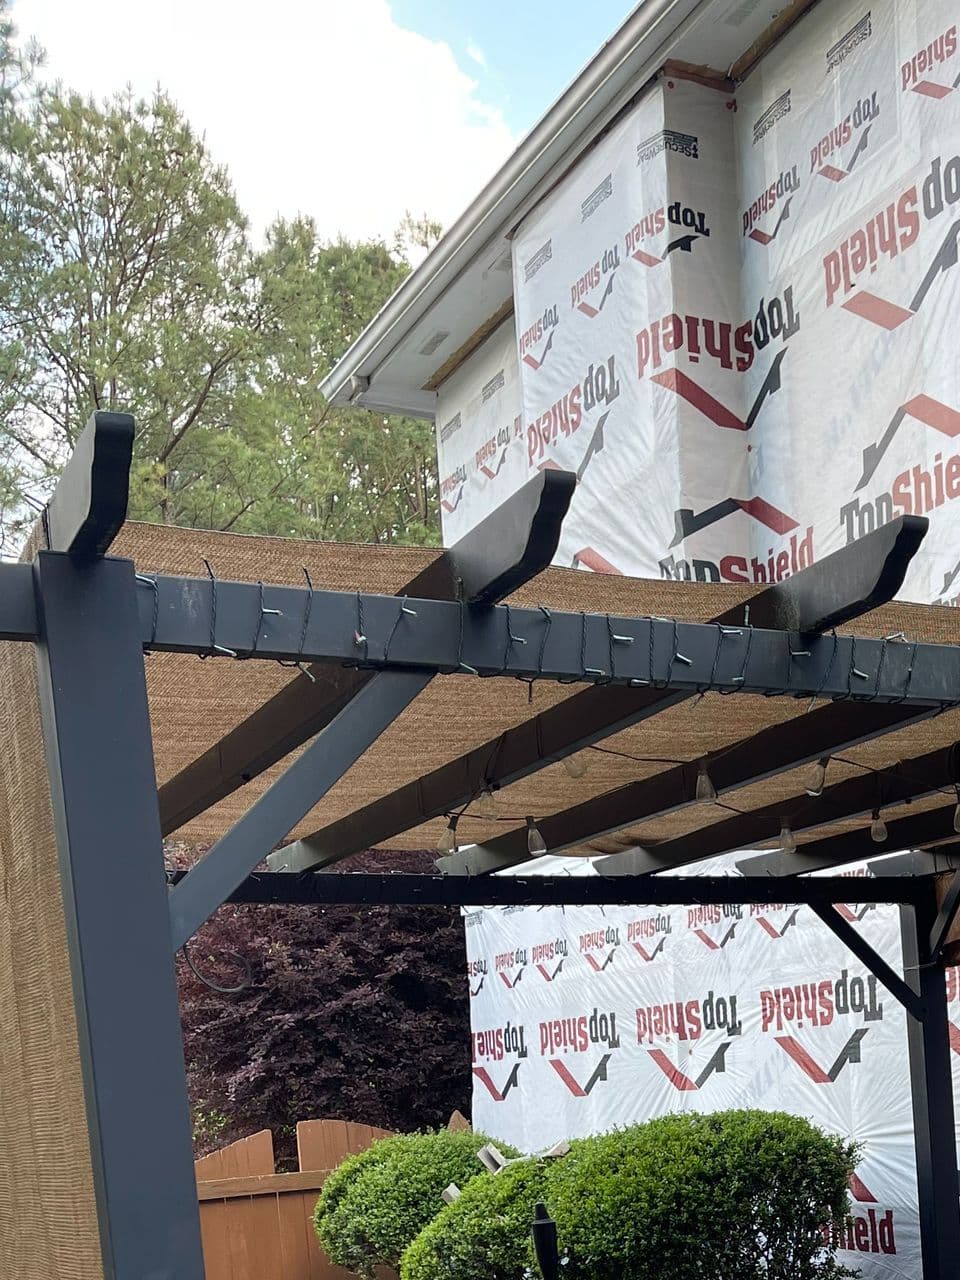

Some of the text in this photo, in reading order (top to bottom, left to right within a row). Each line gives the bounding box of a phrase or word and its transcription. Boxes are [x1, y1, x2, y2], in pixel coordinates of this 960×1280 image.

[743, 165, 800, 236] TopShield
[636, 285, 800, 382] TopShield
[527, 354, 620, 466] TopShield
[539, 1008, 620, 1056] TopShield
[636, 991, 742, 1045] TopShield
[760, 969, 883, 1032] TopShield
